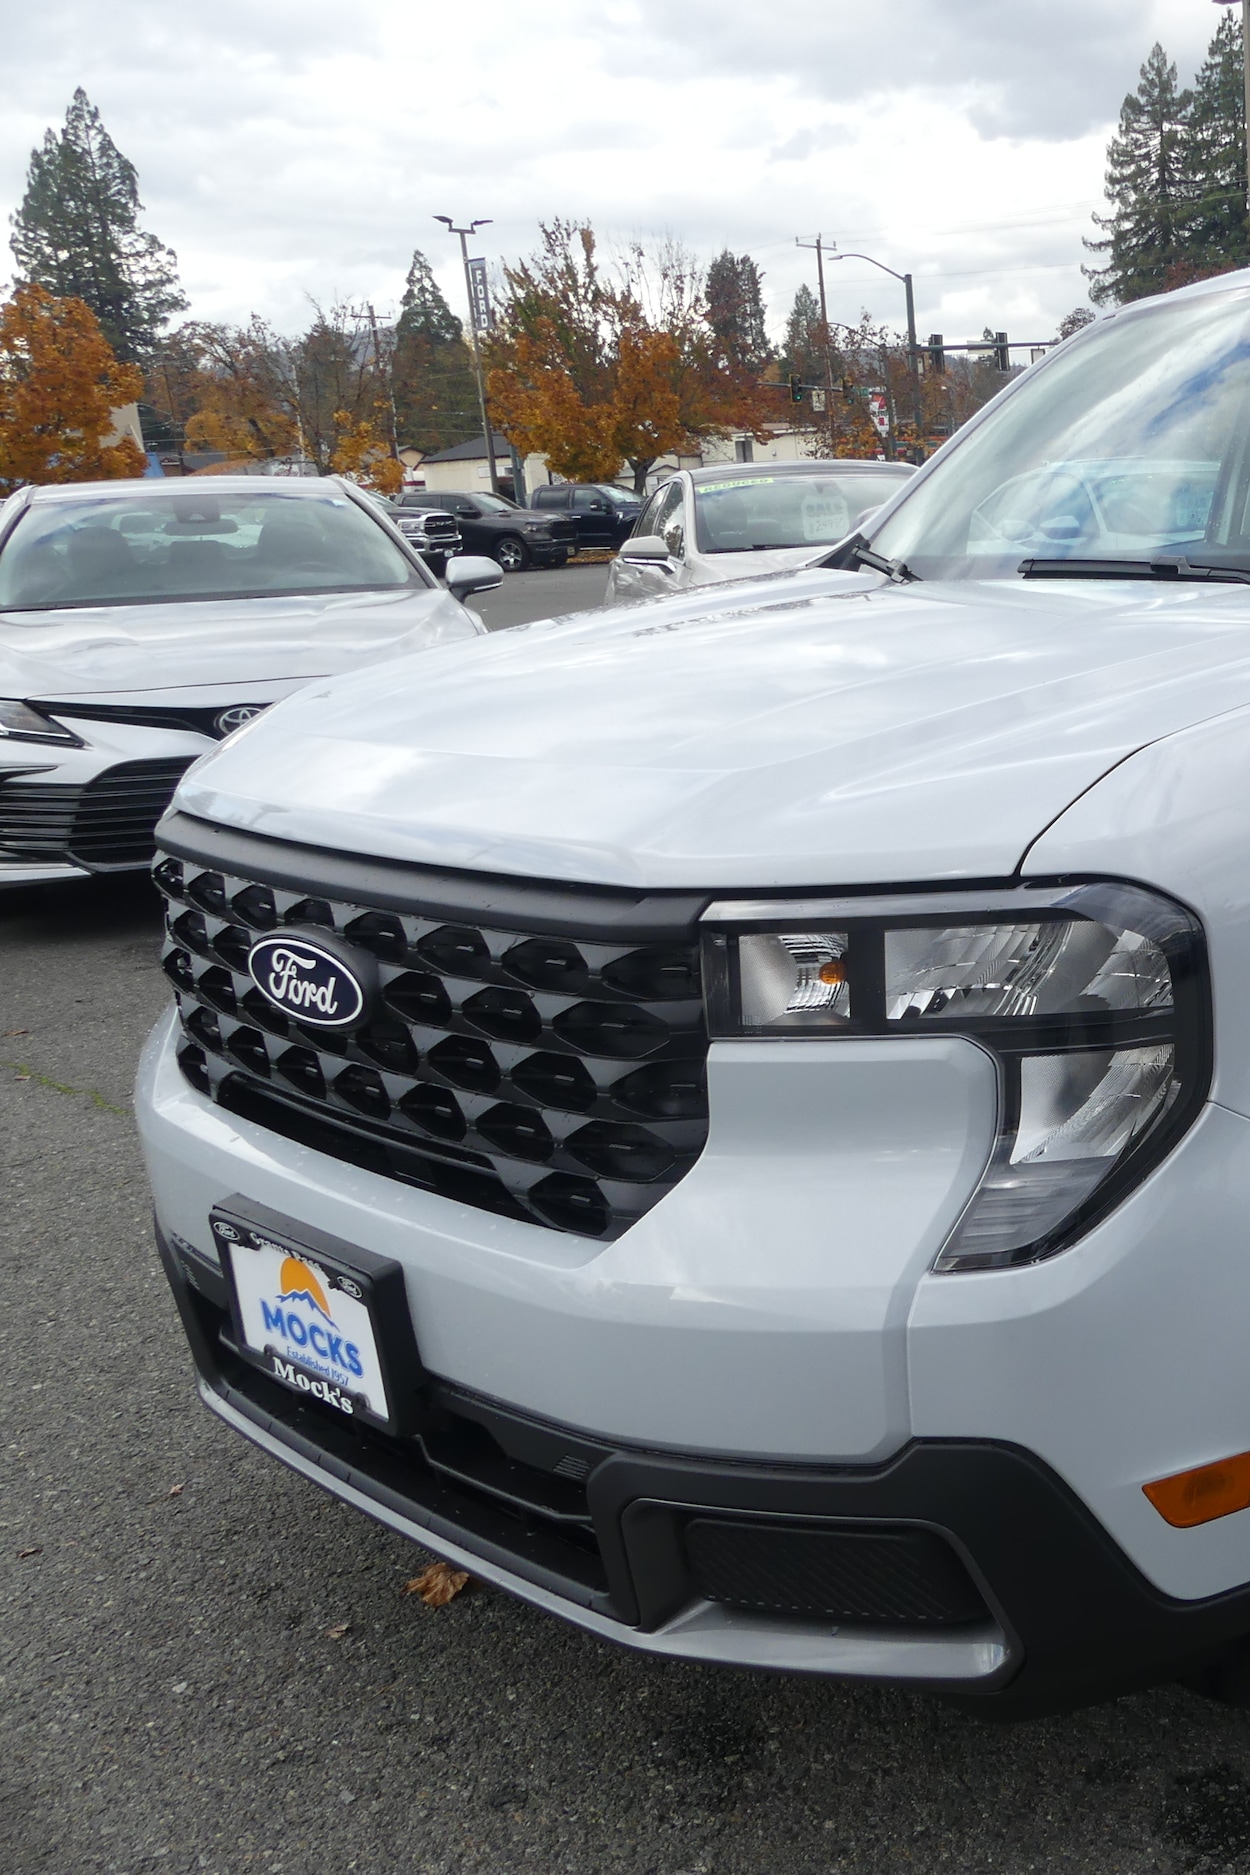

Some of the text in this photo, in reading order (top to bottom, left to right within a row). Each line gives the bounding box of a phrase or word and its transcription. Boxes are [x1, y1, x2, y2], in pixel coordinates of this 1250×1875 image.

[475, 269, 489, 328] FORD
[269, 948, 338, 1015] Ford
[260, 1298, 364, 1378] MOCKS
[286, 1345, 349, 1386] Established 1957
[272, 1356, 354, 1415] Mock's
